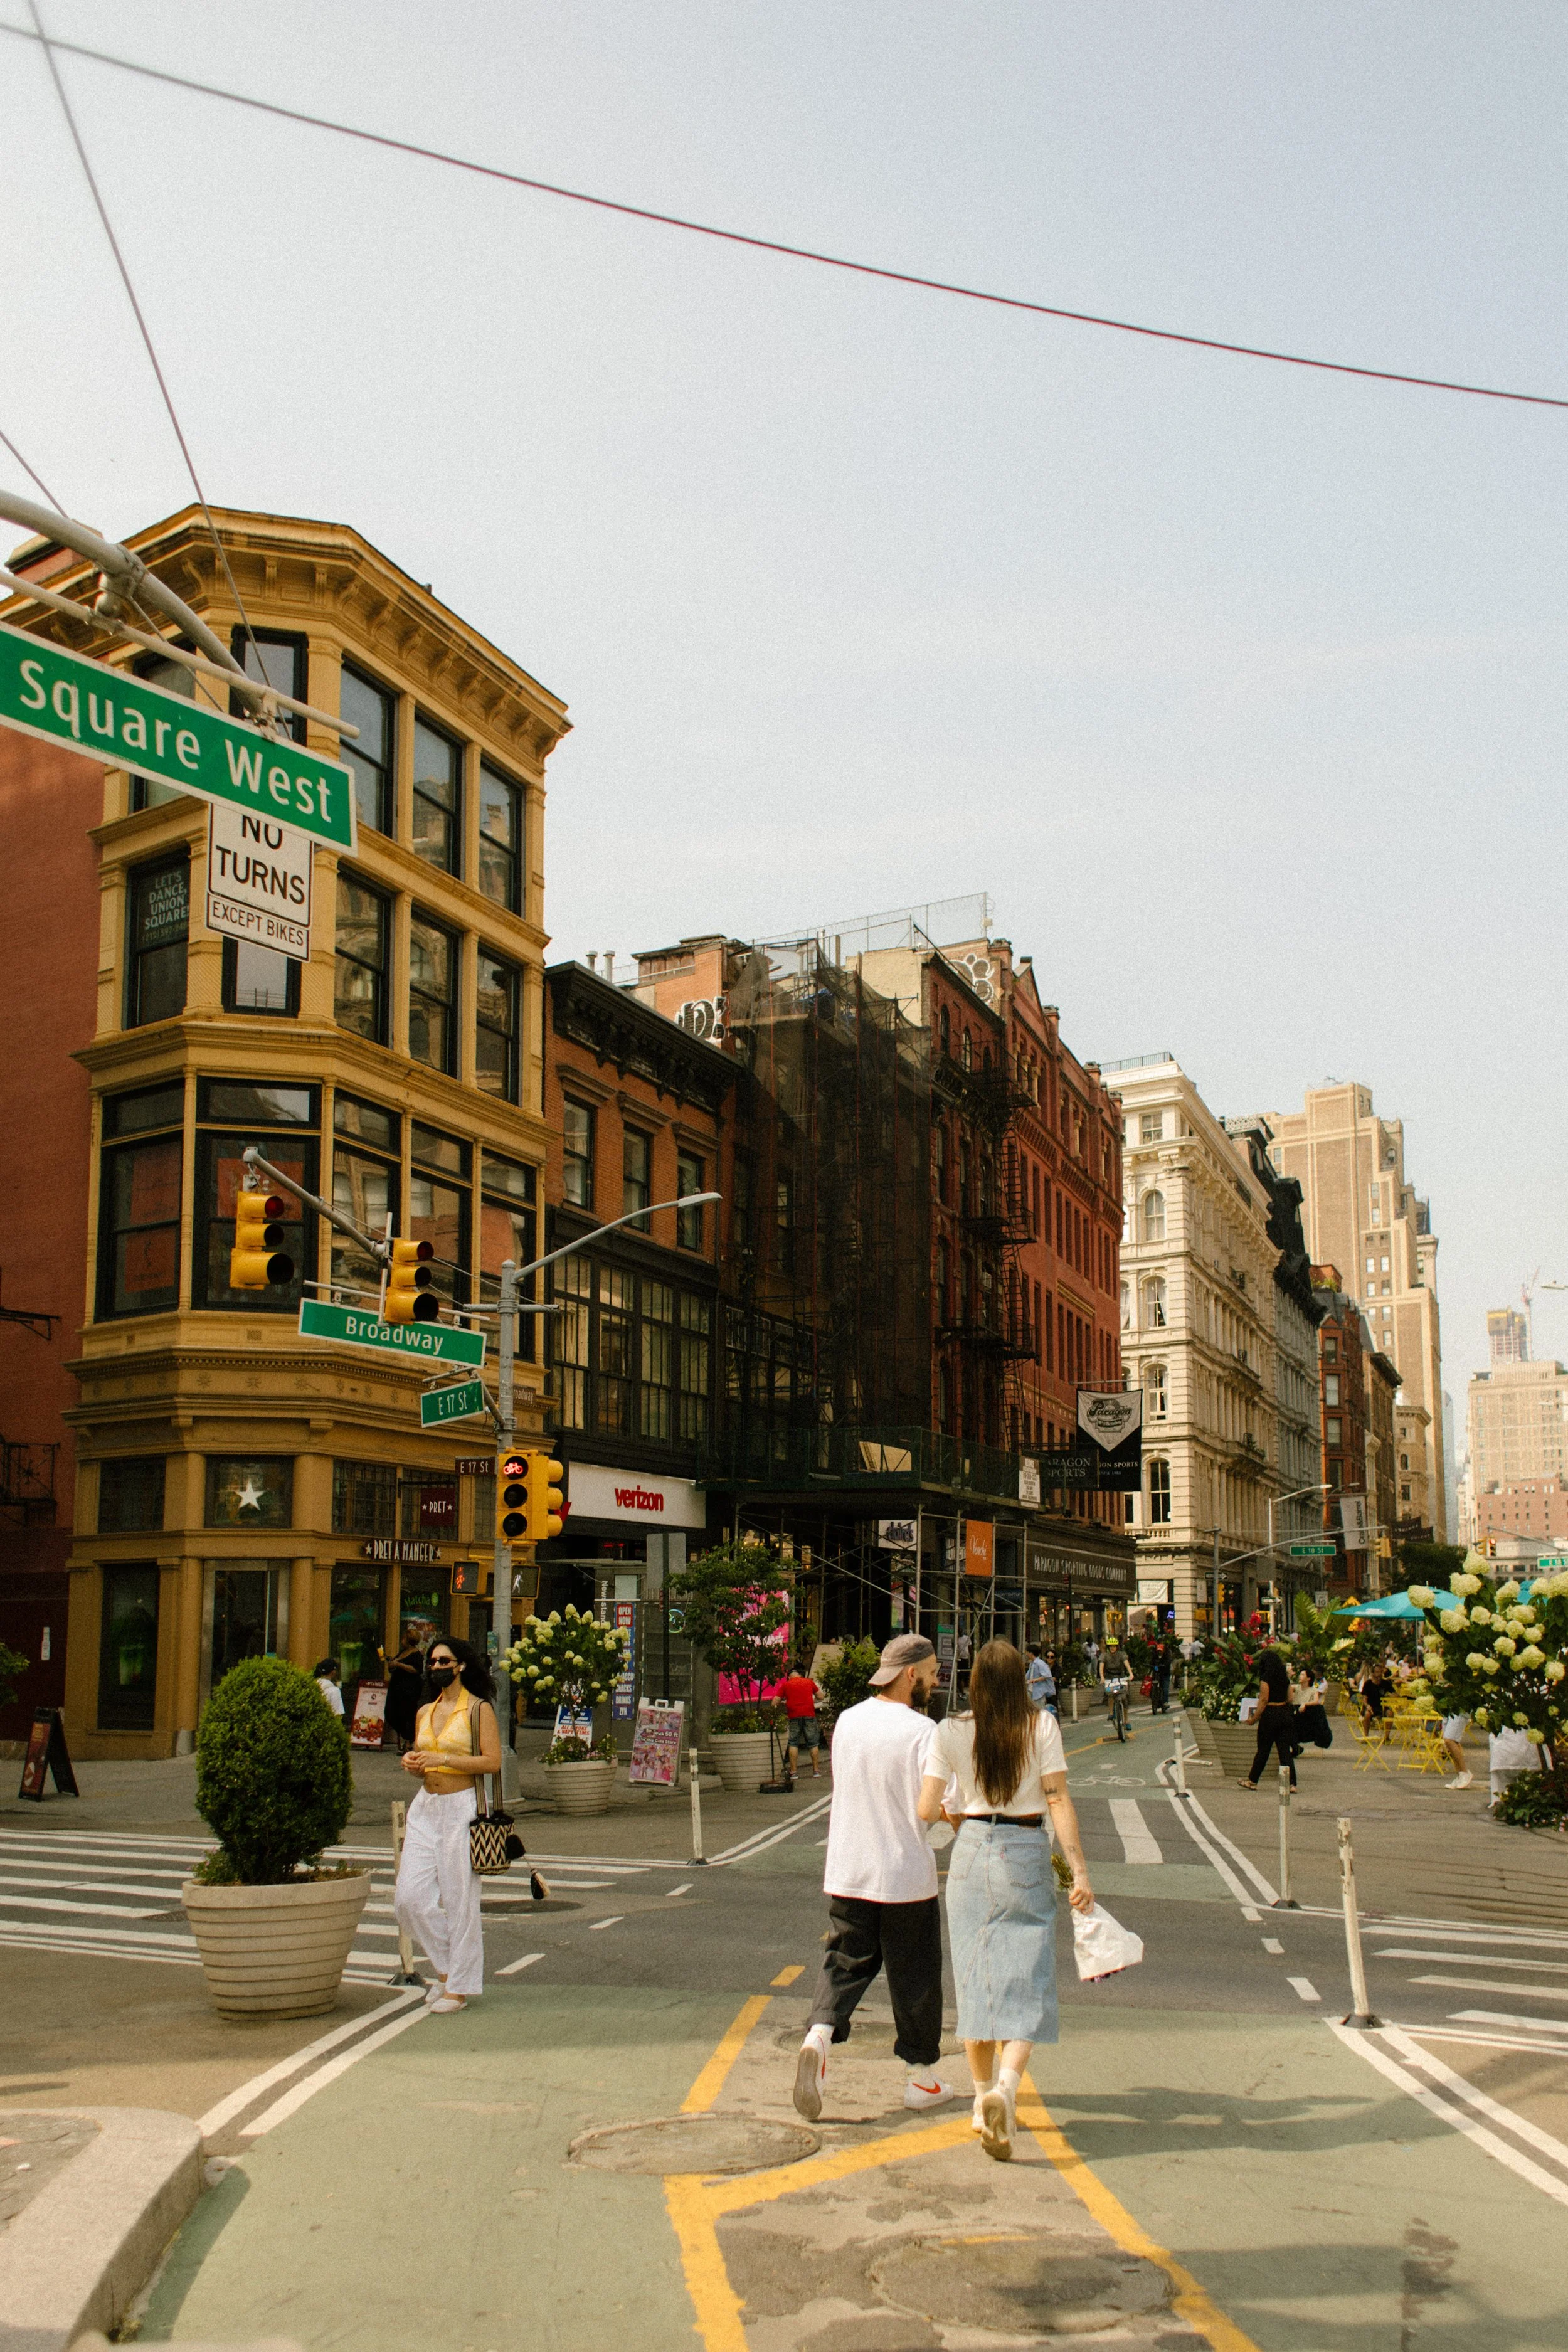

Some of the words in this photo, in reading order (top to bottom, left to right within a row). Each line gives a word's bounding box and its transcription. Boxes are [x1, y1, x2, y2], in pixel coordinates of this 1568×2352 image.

[19, 660, 201, 770] Square
[225, 739, 332, 824] West
[242, 815, 282, 850] NO
[155, 871, 181, 889] LET'S
[216, 845, 305, 904] TURNS
[149, 882, 187, 904] DANCE,
[151, 894, 185, 915] UNION
[213, 901, 262, 932] EXCEPT
[267, 919, 304, 946] BIKES
[346, 1316, 443, 1355] Broadway
[438, 1397, 443, 1416] E
[447, 1394, 455, 1414] 17
[458, 1391, 467, 1411] St
[514, 1388, 534, 1405] roadway
[1088, 1398, 1133, 1420] Paragon
[460, 1462, 465, 1473] E
[468, 1461, 476, 1473] 17
[480, 1461, 489, 1473] St
[429, 1501, 446, 1513] PRET
[615, 1485, 664, 1512] verizon
[374, 1539, 392, 1560] PRET
[394, 1541, 400, 1560] A
[402, 1542, 433, 1562] MANGER
[1034, 1555, 1059, 1572] PARAGON
[1061, 1560, 1087, 1577] SPORTING
[1106, 1567, 1126, 1581] COMPANY
[600, 1580, 608, 1624] Newstan
[618, 1606, 632, 1616] OPEN
[618, 1616, 632, 1626] NOW
[616, 1683, 632, 1693] SNACKS
